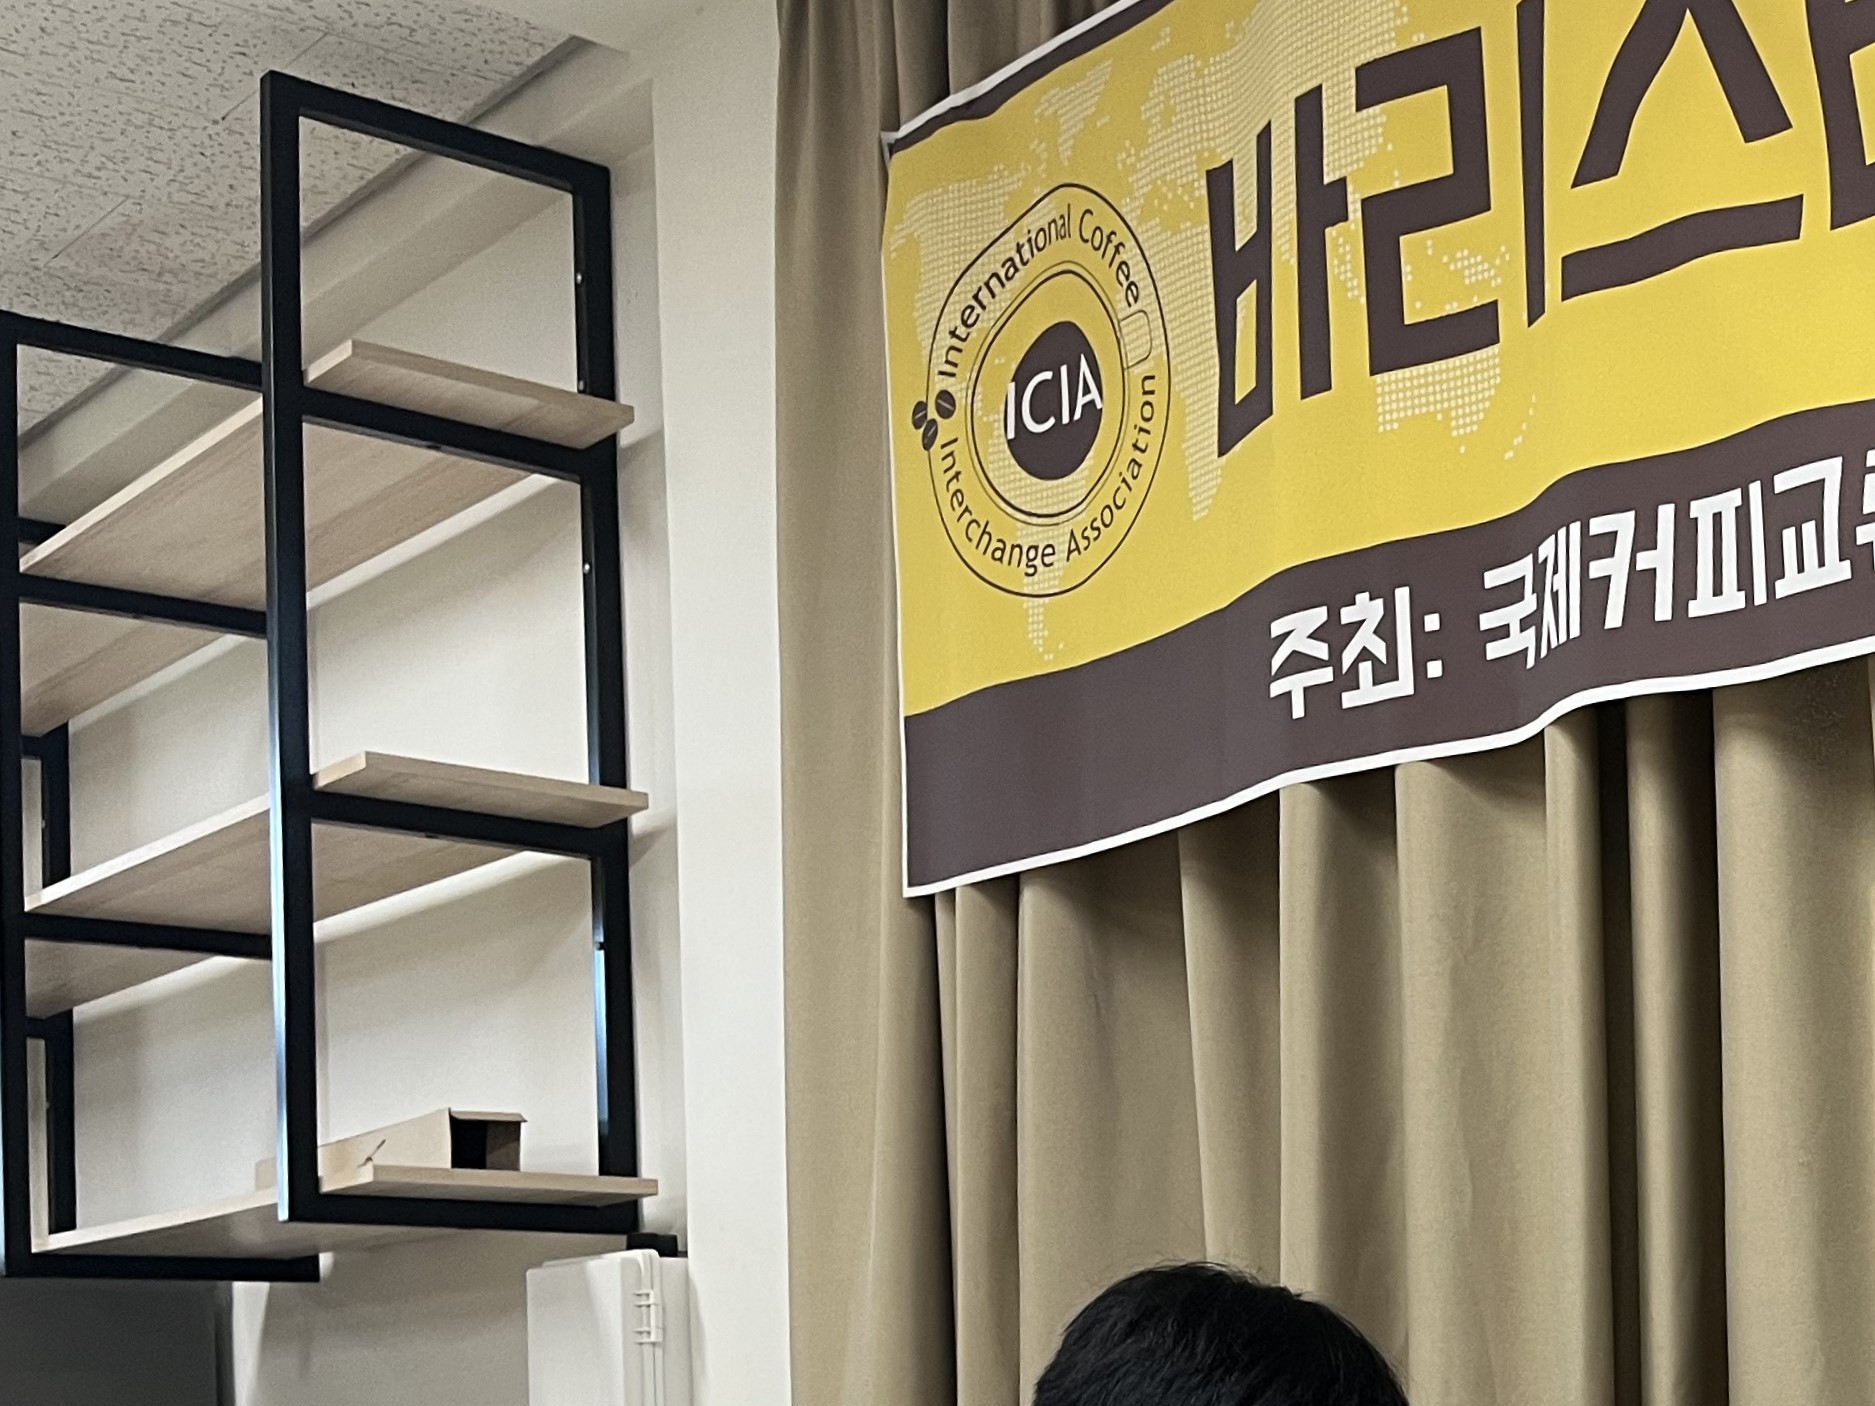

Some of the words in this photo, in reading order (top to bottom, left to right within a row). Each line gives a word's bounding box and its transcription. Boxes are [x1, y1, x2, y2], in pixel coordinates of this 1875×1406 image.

[937, 203, 1072, 379] International
[1078, 208, 1140, 308] Coffee
[1004, 353, 1104, 440] ICIA
[940, 436, 1056, 577] Interchange
[1066, 374, 1156, 563] Association
[1269, 586, 1444, 720] 주최:
